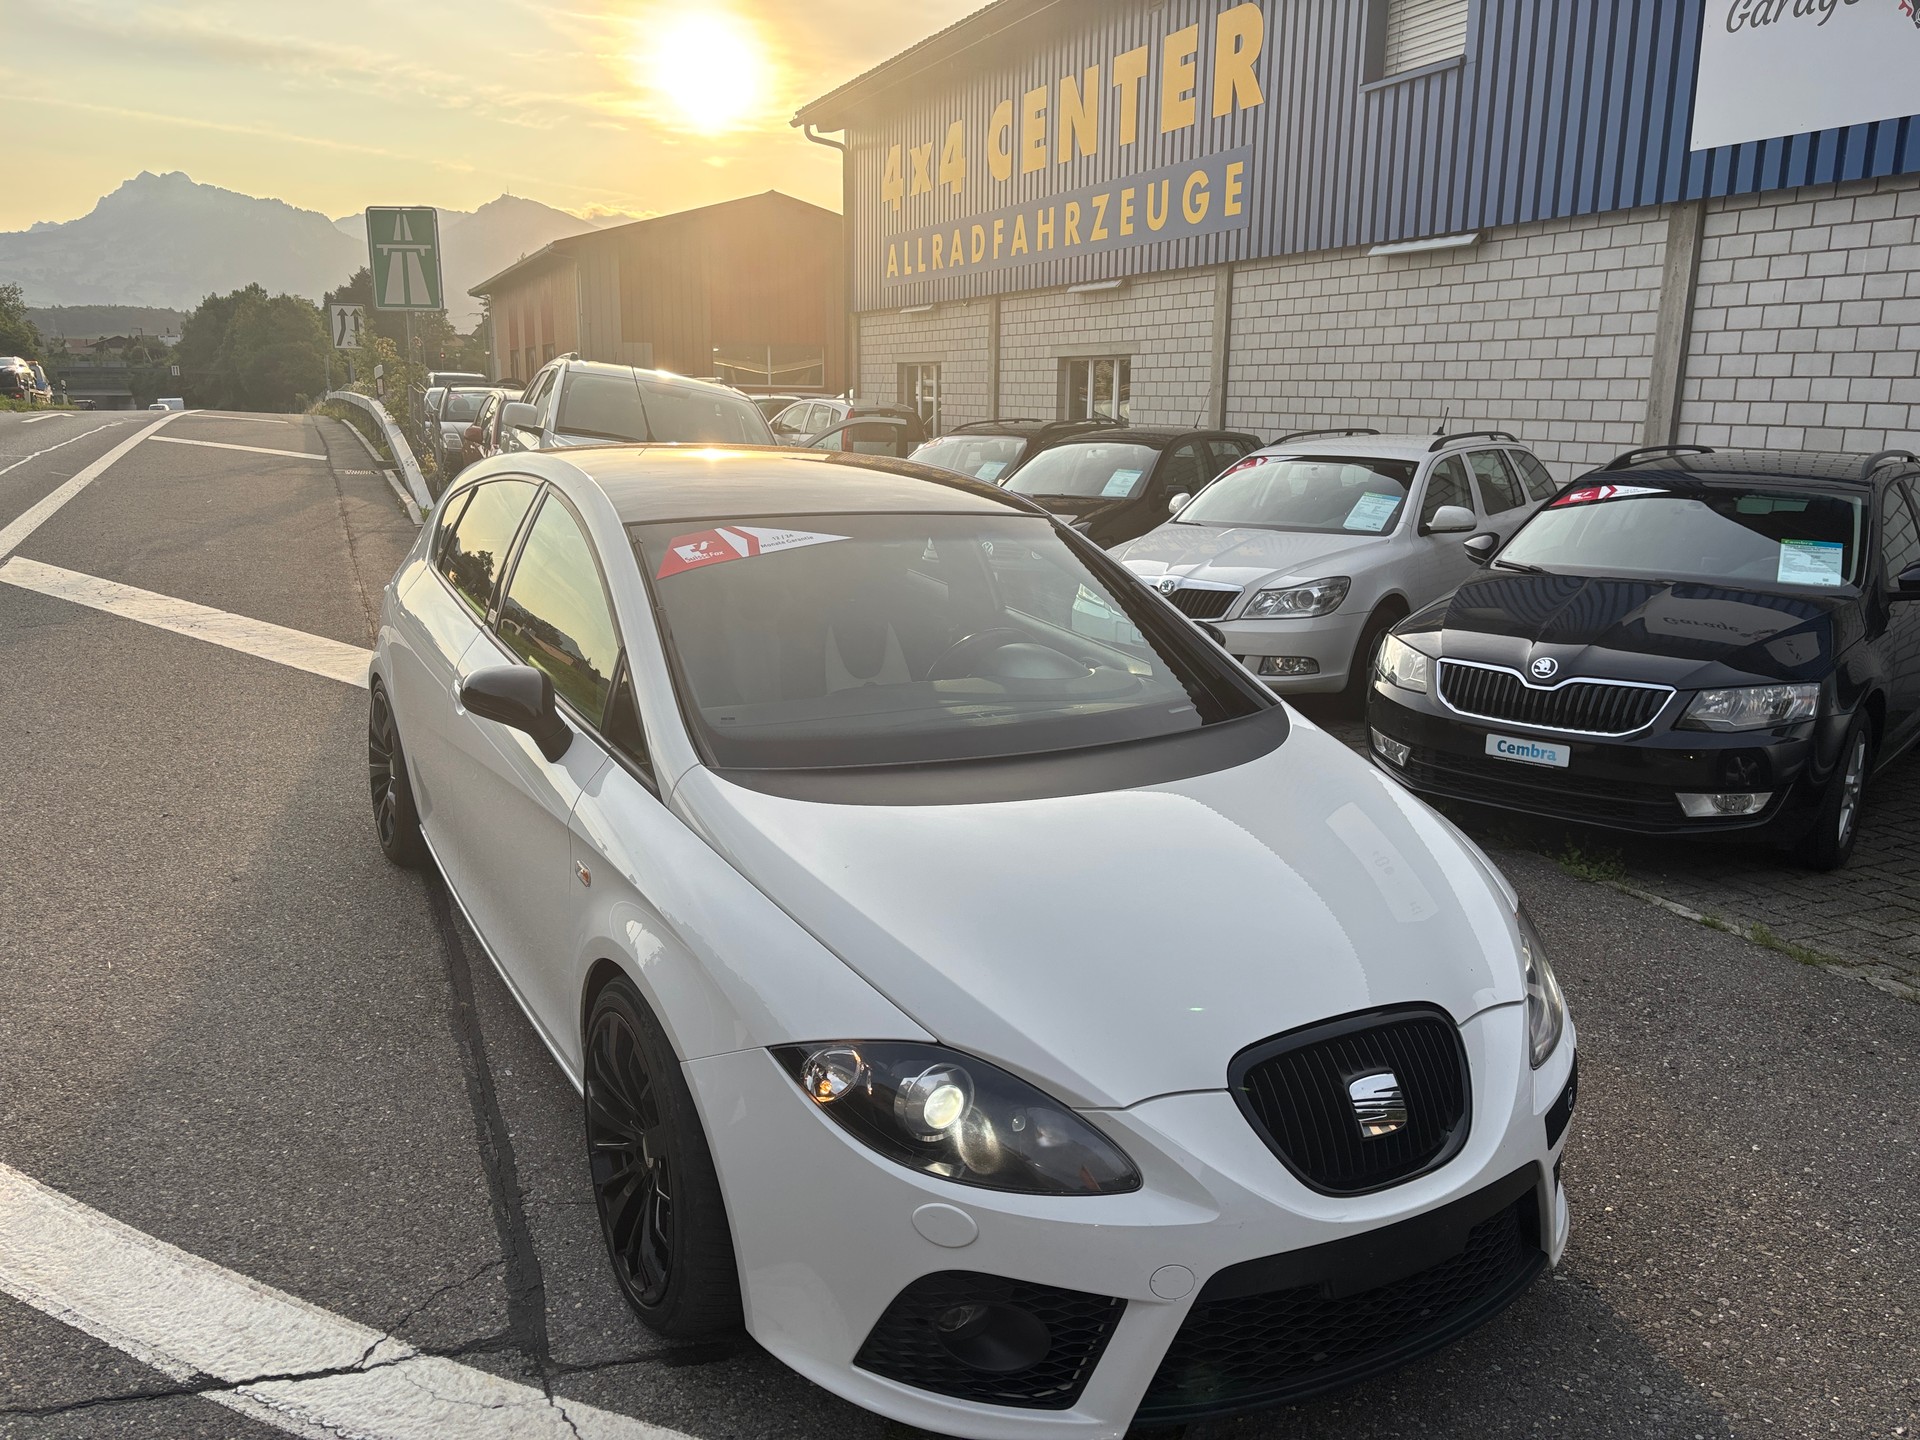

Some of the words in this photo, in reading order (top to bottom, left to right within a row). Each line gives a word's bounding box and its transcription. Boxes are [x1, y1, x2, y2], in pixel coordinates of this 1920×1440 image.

[1726, 0, 1859, 33] Garag
[881, 119, 966, 211] 4x4
[988, 2, 1265, 182] CENTER
[886, 161, 1244, 279] ALLRADFAHRZEUGE
[1497, 740, 1557, 761] Cembra
